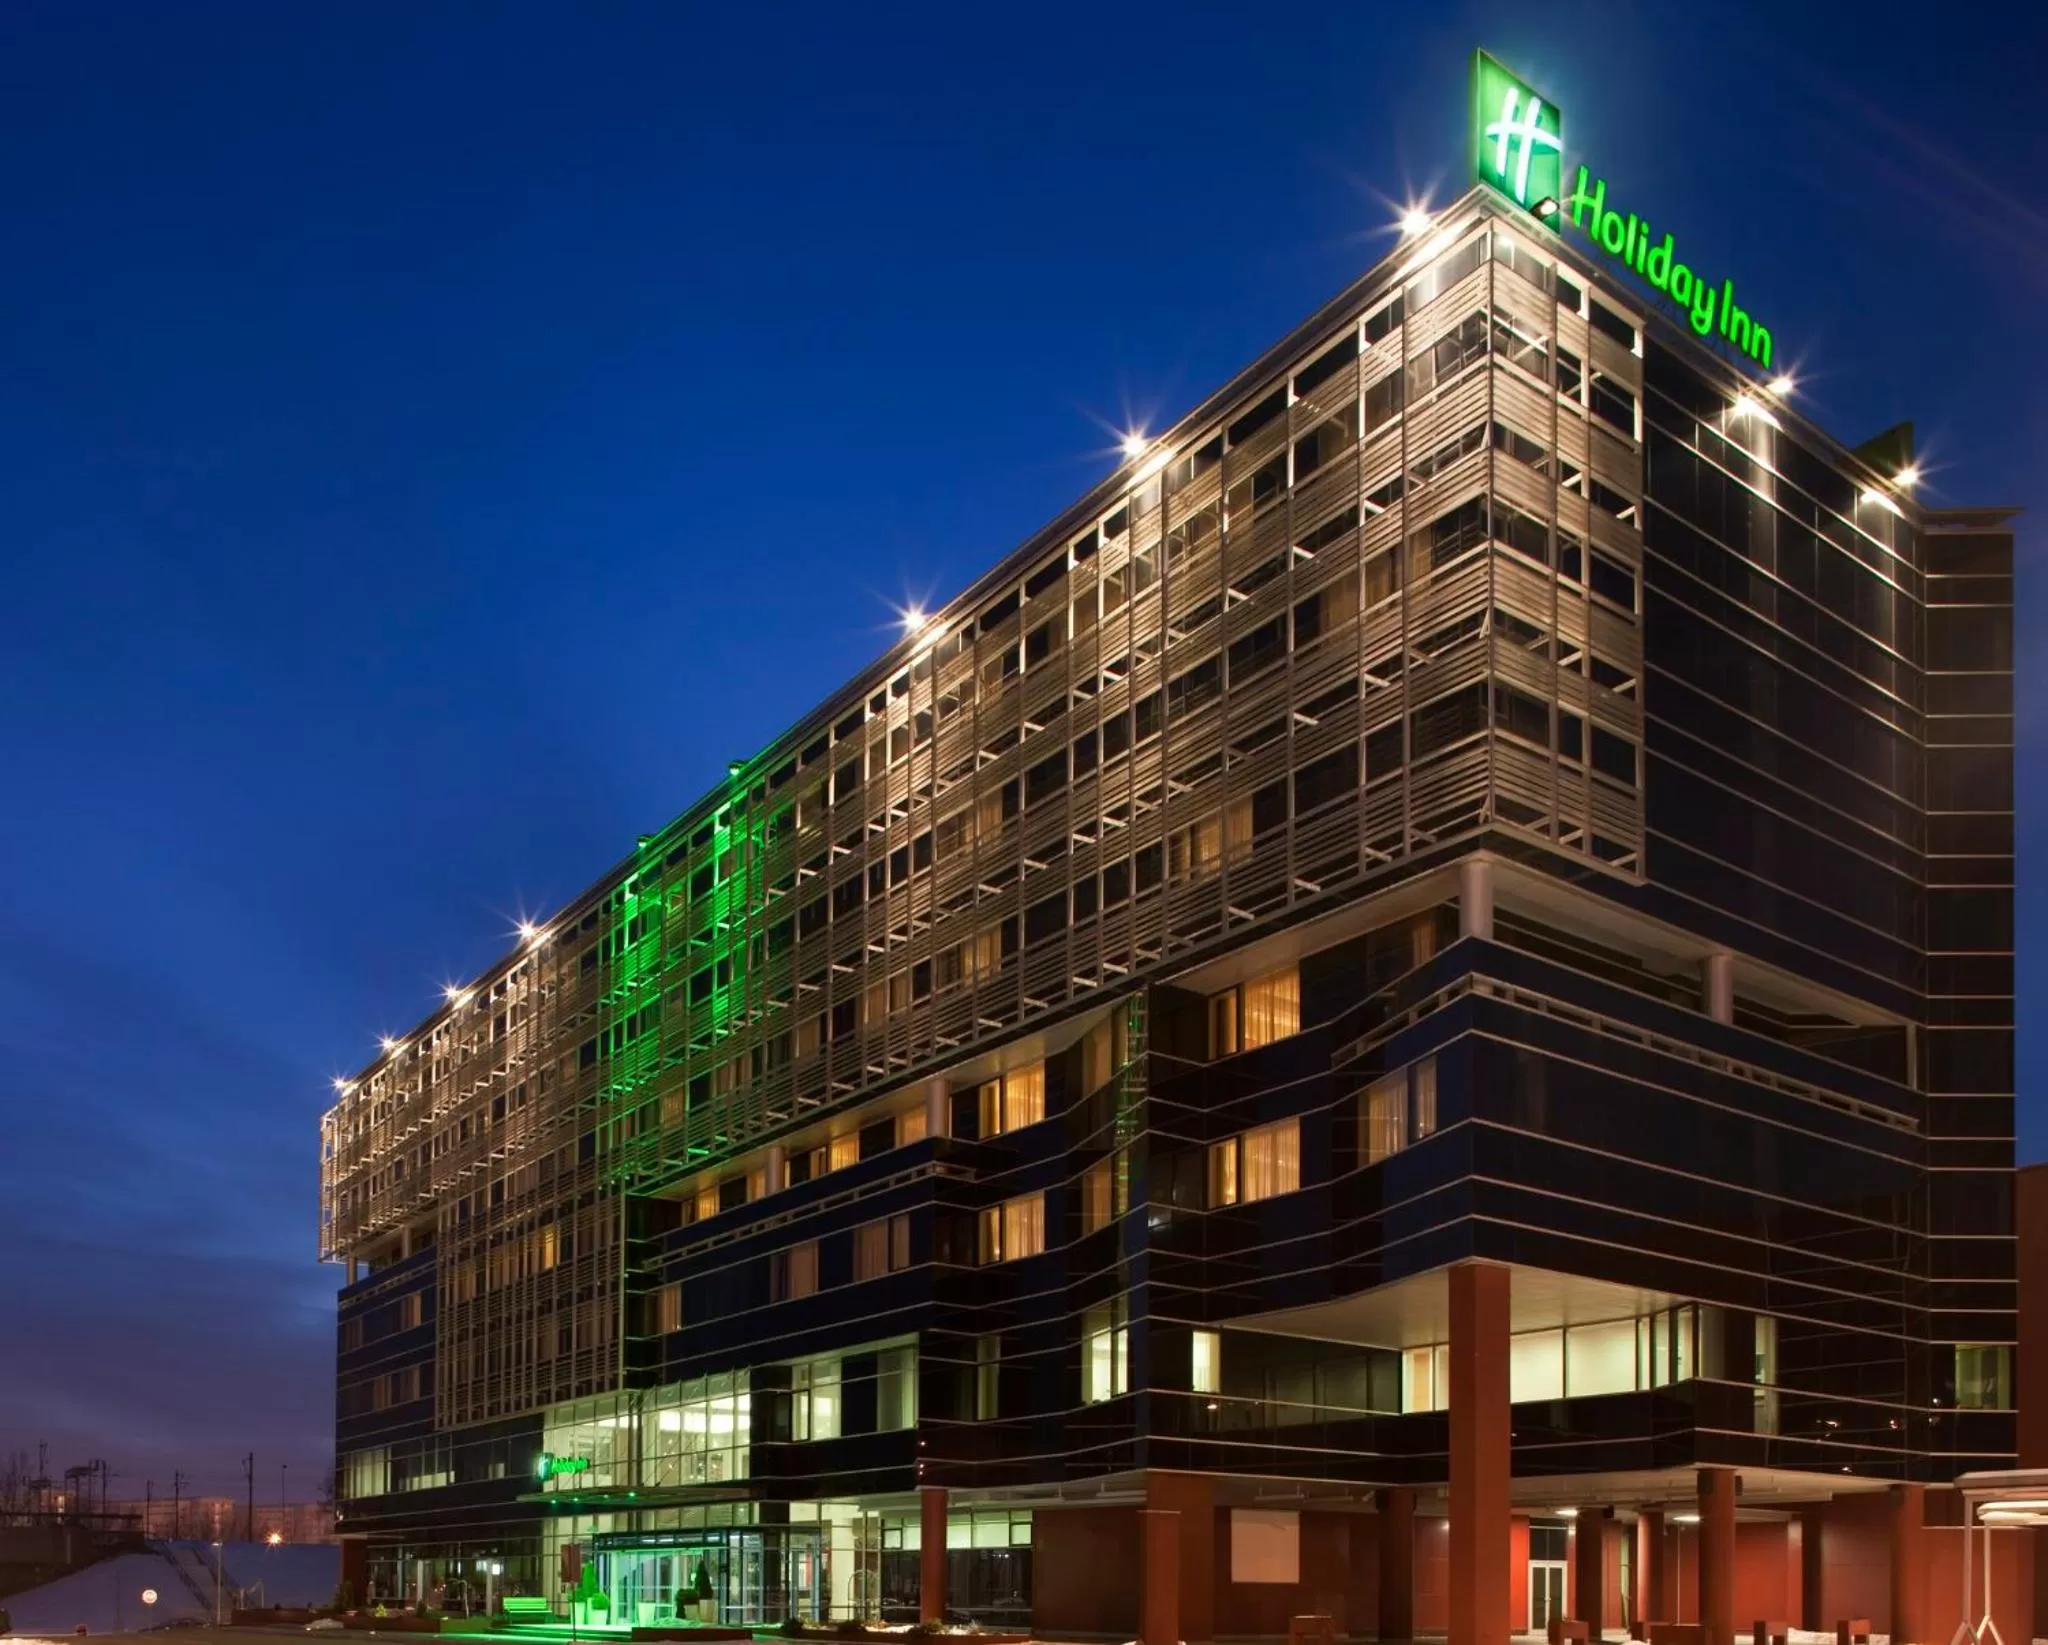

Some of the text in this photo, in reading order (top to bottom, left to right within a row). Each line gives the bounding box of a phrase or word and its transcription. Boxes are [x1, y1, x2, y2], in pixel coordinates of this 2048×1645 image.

[1485, 87, 1563, 206] H
[1570, 164, 1773, 369] Holiday Inn
